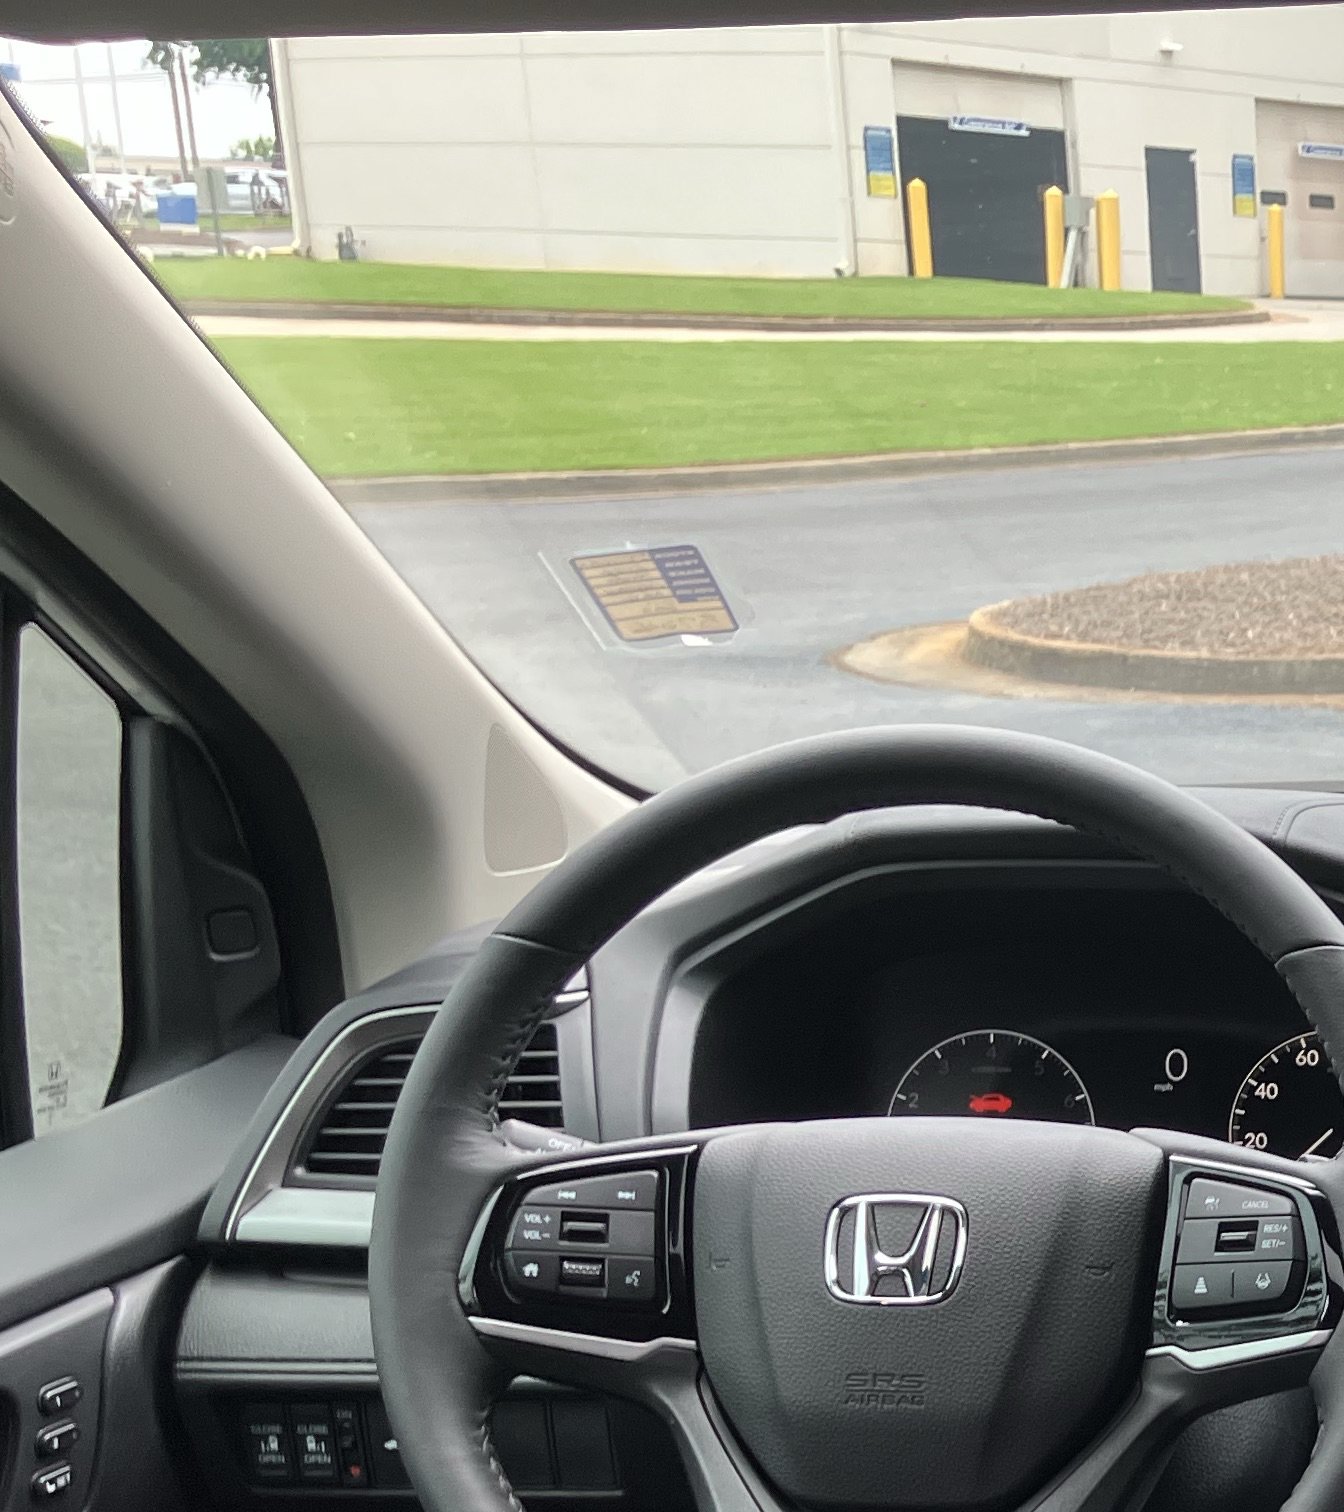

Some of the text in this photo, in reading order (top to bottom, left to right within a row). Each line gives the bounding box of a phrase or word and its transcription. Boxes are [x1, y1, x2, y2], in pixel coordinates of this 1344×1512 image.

[1165, 1048, 1188, 1082] 0
[1295, 1049, 1319, 1067] 60
[1254, 1083, 1279, 1100] 40
[1244, 1132, 1268, 1149] 20
[1242, 1200, 1270, 1209] CANCEL
